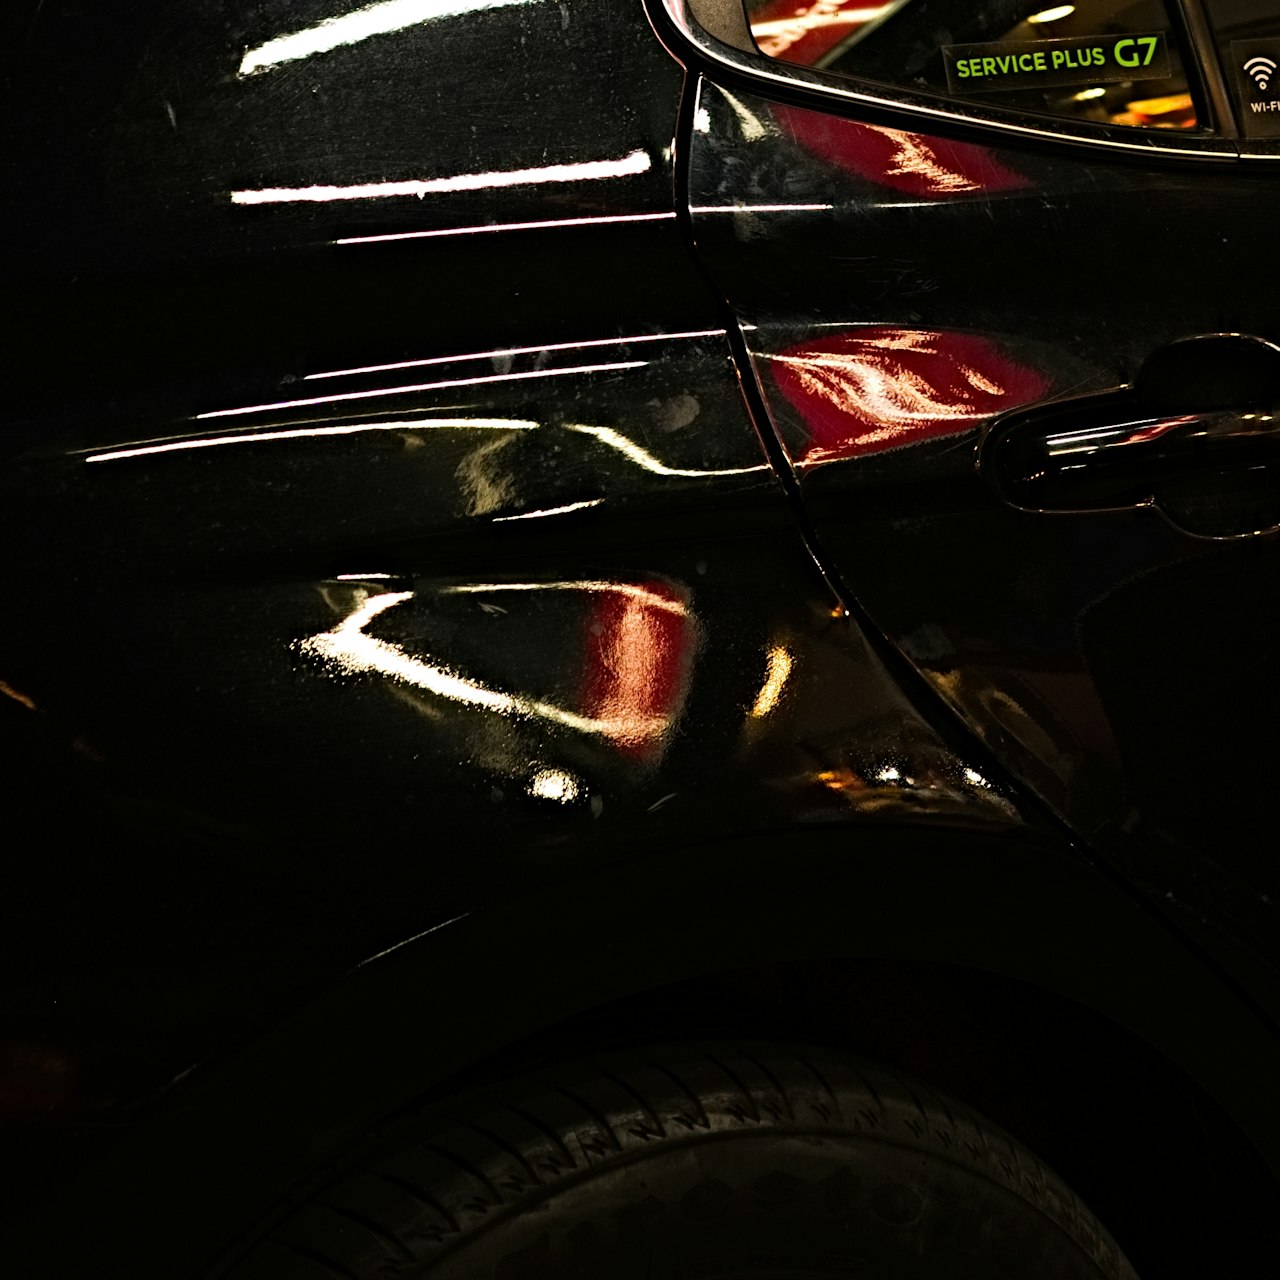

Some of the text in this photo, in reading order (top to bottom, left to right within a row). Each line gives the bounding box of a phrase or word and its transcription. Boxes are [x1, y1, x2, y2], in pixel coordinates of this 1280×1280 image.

[956, 36, 1158, 79] SERVICE PLUS G7
[1250, 100, 1280, 113] WI-FI
